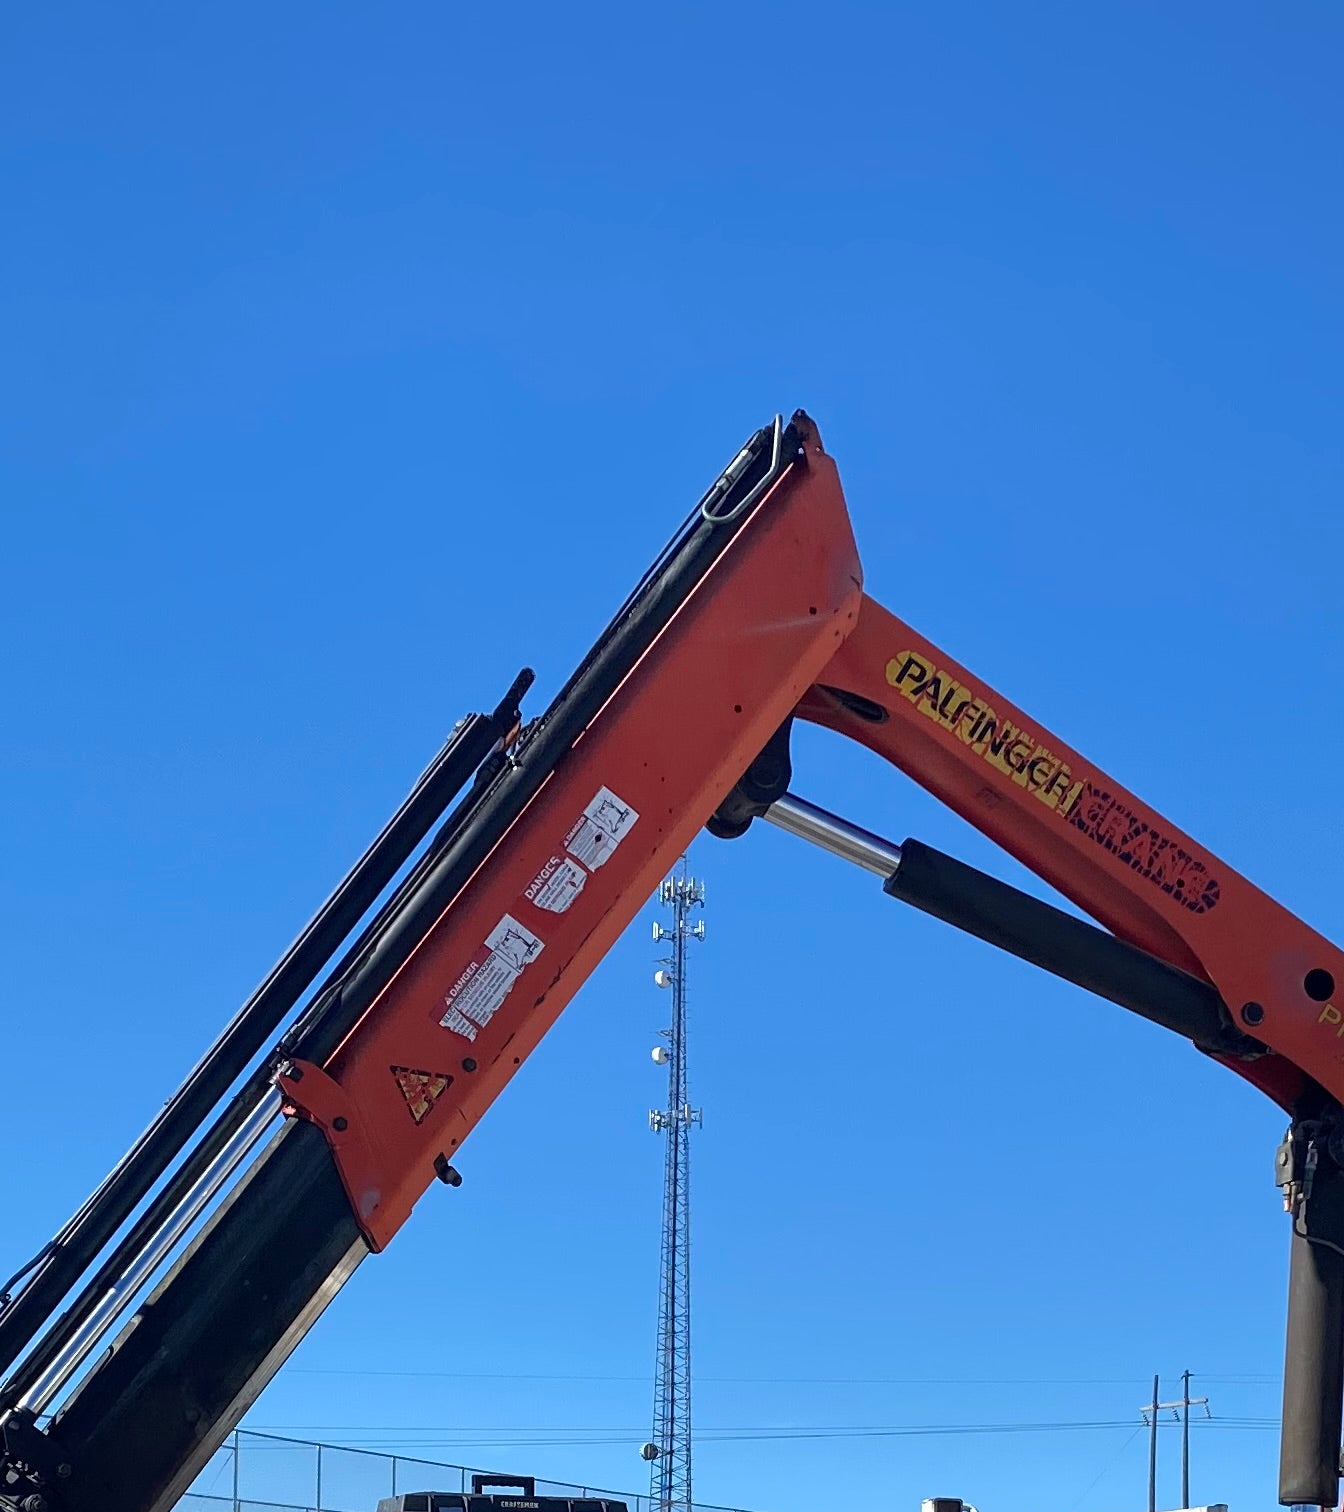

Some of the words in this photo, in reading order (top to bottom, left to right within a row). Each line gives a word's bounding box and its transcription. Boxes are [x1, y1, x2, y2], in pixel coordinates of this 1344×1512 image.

[895, 656, 1072, 807] PALFINGER
[449, 961, 480, 998] DANGER
[500, 1501, 540, 1510] CRAFTSMAN
